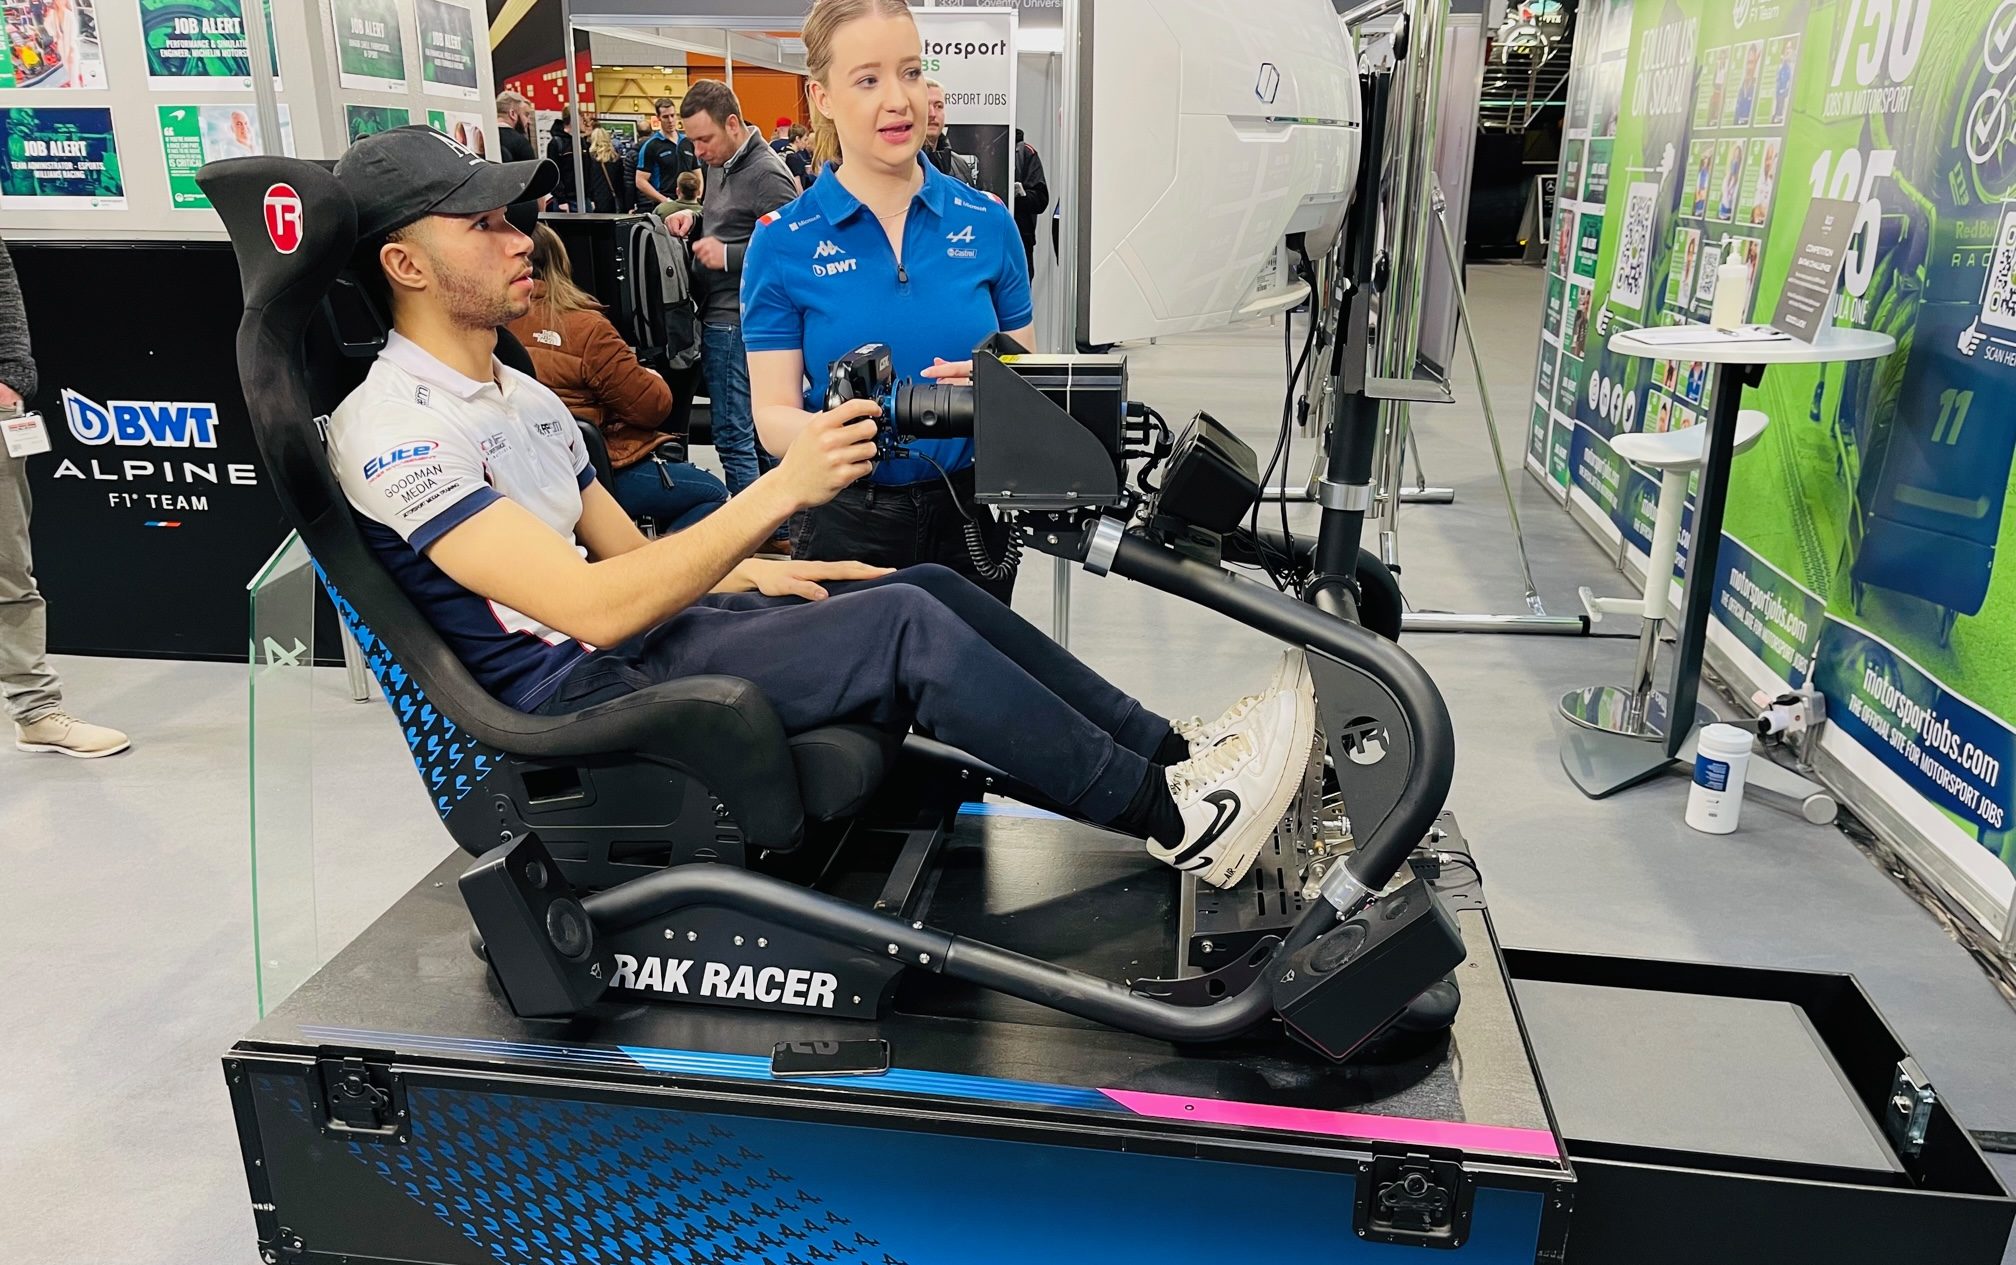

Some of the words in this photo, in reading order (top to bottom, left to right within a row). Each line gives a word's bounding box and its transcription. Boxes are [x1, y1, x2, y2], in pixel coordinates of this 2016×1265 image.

[174, 17, 199, 34] JOB
[202, 17, 241, 34] ALERT
[925, 39, 1006, 60] torsport
[922, 59, 940, 72] BS
[945, 93, 980, 106] RSPORT
[984, 93, 1007, 106] JOBS
[1851, 85, 1913, 116] MOTORSPORT
[24, 140, 48, 156] JOB
[50, 140, 87, 156] ALERT
[963, 201, 987, 212] Microsoft
[954, 249, 975, 257] Castrol
[826, 258, 857, 276] BWT
[1984, 345, 2005, 363] SCAN
[108, 401, 219, 448] BWT
[1931, 388, 1975, 445] 11
[53, 458, 258, 485] ALPINE
[384, 464, 442, 498] GOODMAN
[401, 478, 438, 504] MEDIA
[146, 494, 208, 510] TEAM
[1729, 568, 1808, 644] motorsportjobs.com
[1863, 667, 2000, 788] motorsportjobs.com
[1848, 694, 1863, 718] THE
[1861, 705, 1890, 742] OFFICIAL
[1890, 728, 1908, 754] SITE
[1904, 740, 1922, 767] FOR
[1920, 752, 1981, 810] MOTORSPORT
[1977, 796, 2004, 829] JOBS
[1224, 867, 1236, 880] AIR
[609, 954, 694, 995] RAK
[700, 961, 838, 1009] RACER
